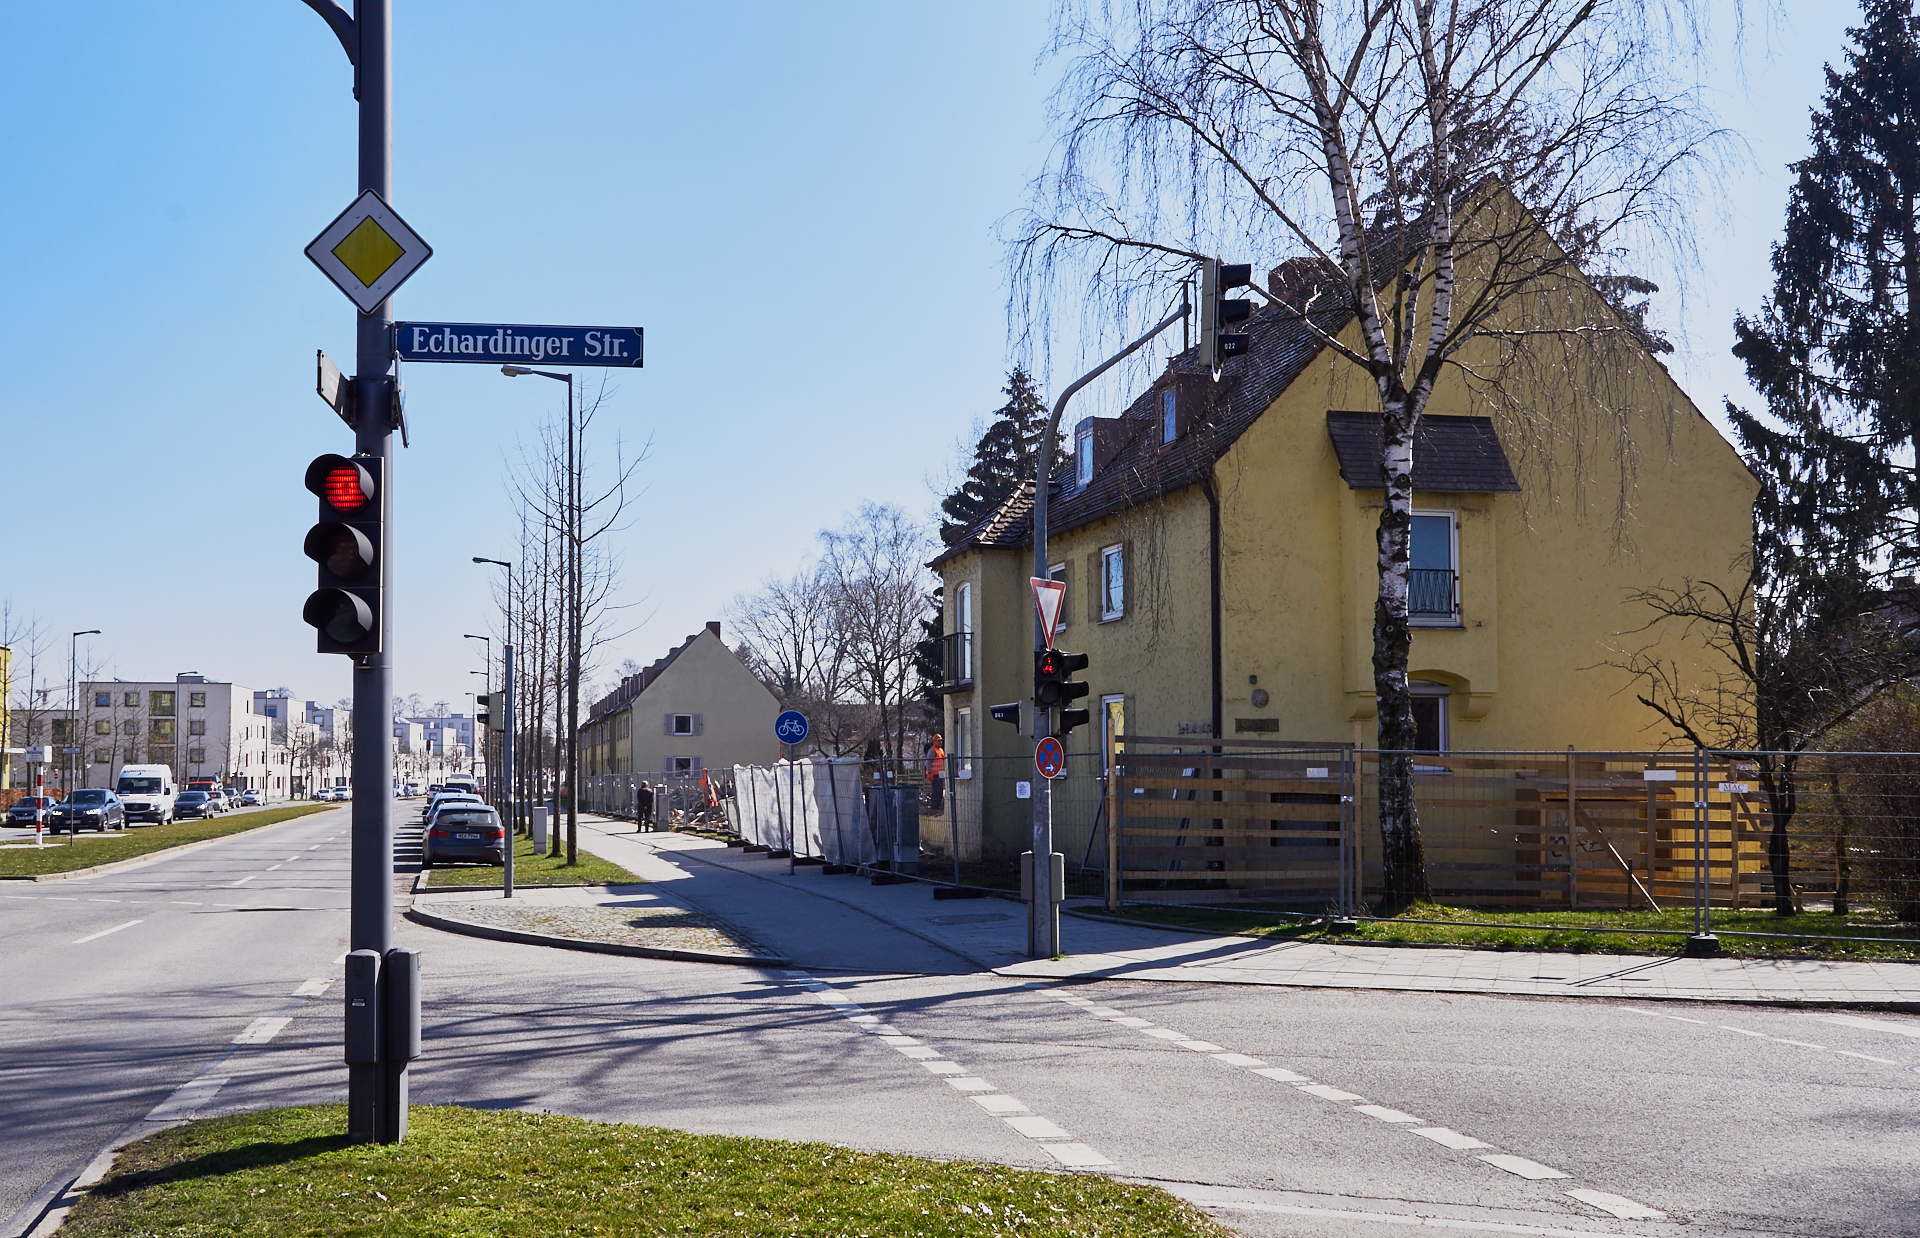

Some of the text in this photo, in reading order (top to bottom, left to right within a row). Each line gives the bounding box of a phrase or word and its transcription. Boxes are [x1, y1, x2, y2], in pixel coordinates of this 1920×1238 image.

[411, 327, 628, 361] Echardinger Str.
[1723, 783, 1744, 791] MAC
